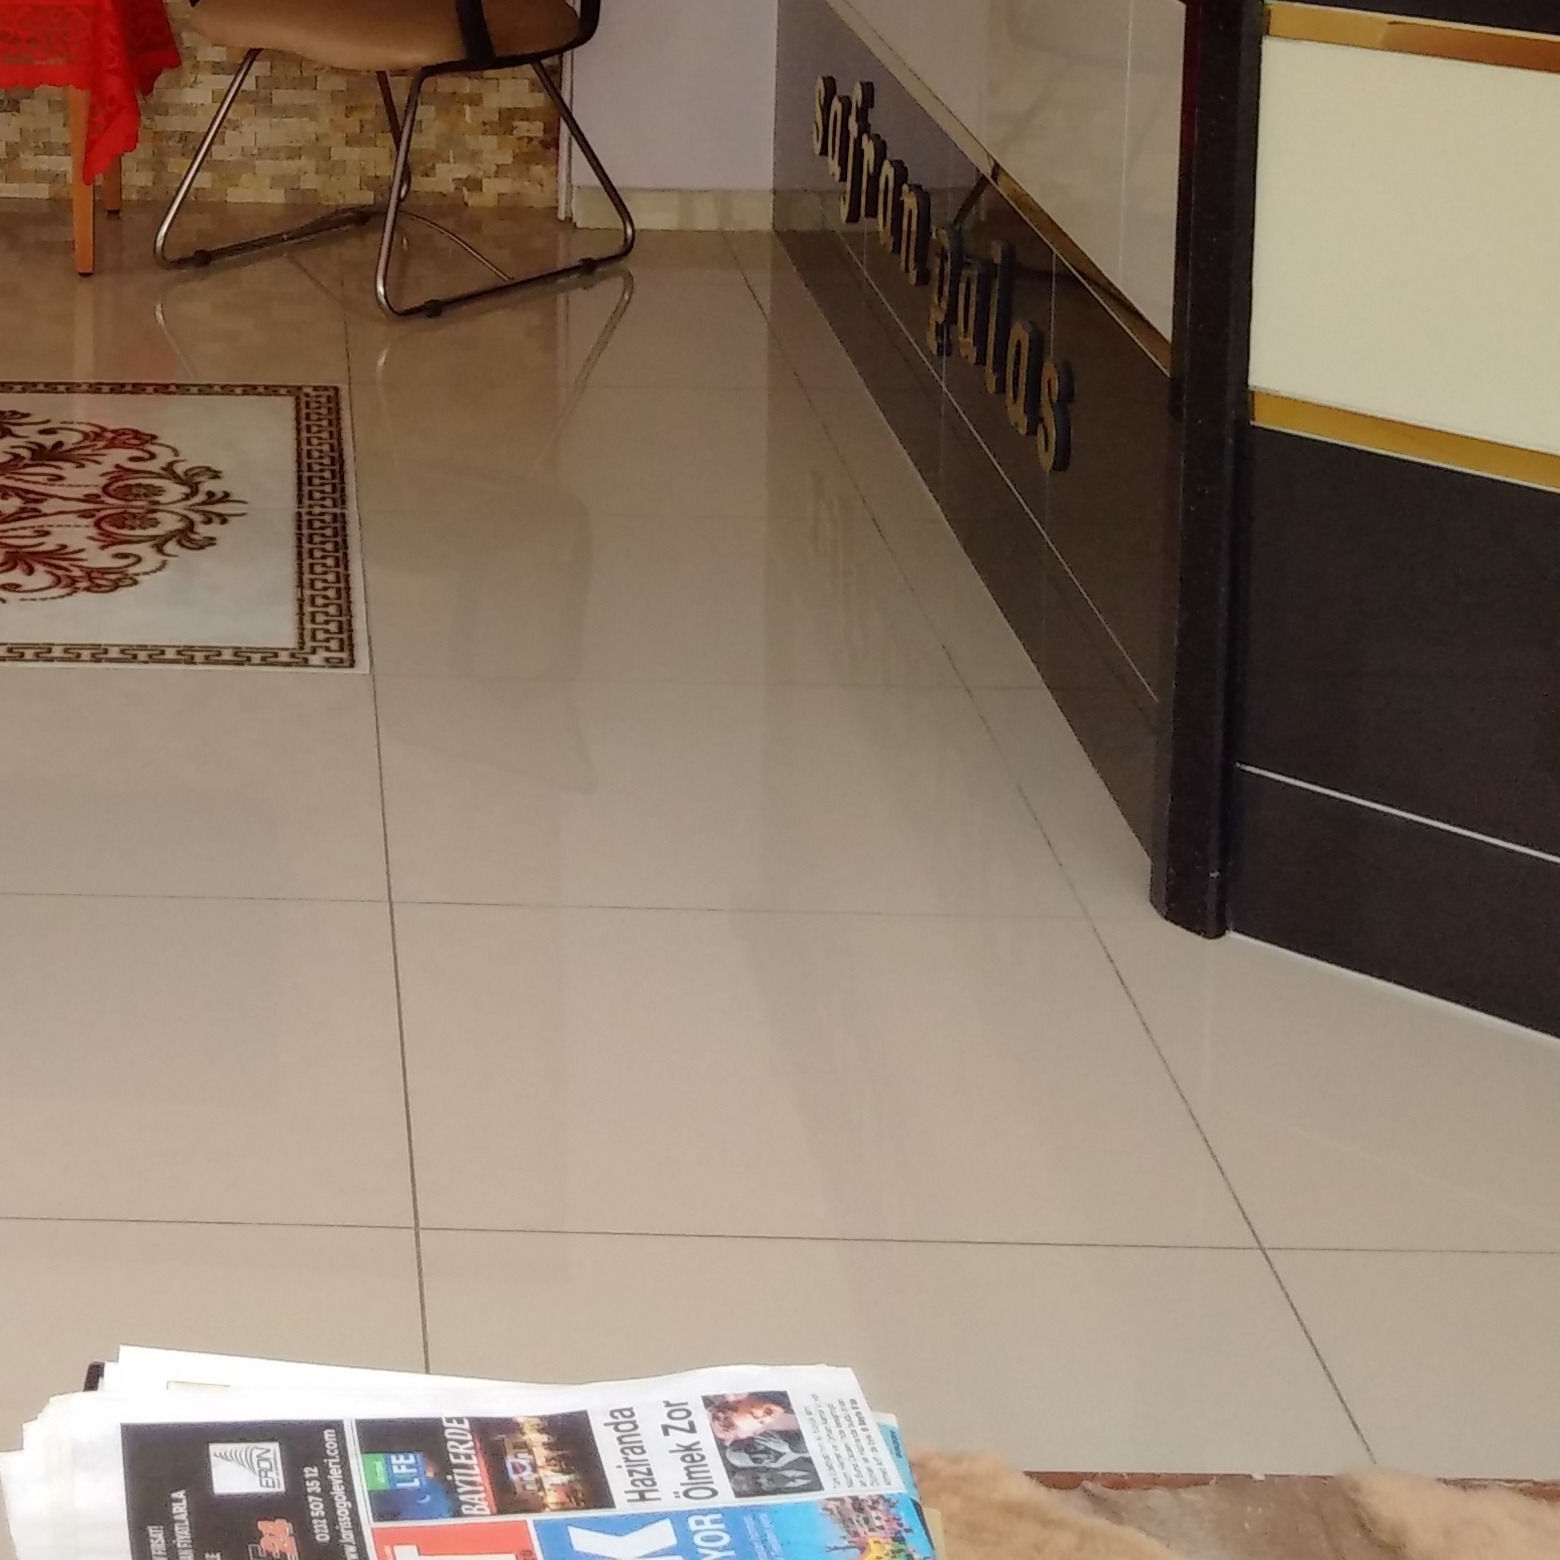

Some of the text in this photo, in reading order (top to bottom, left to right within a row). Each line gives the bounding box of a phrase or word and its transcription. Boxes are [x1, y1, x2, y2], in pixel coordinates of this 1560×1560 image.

[813, 75, 1074, 472] safran palas
[303, 1465, 319, 1479] 12
[306, 1479, 322, 1494] 35
[441, 1416, 492, 1517] BAYİLERDE
[604, 1406, 662, 1503] Haziranda
[661, 1399, 719, 1500] Ölmek Zor
[308, 1494, 325, 1516] 507
